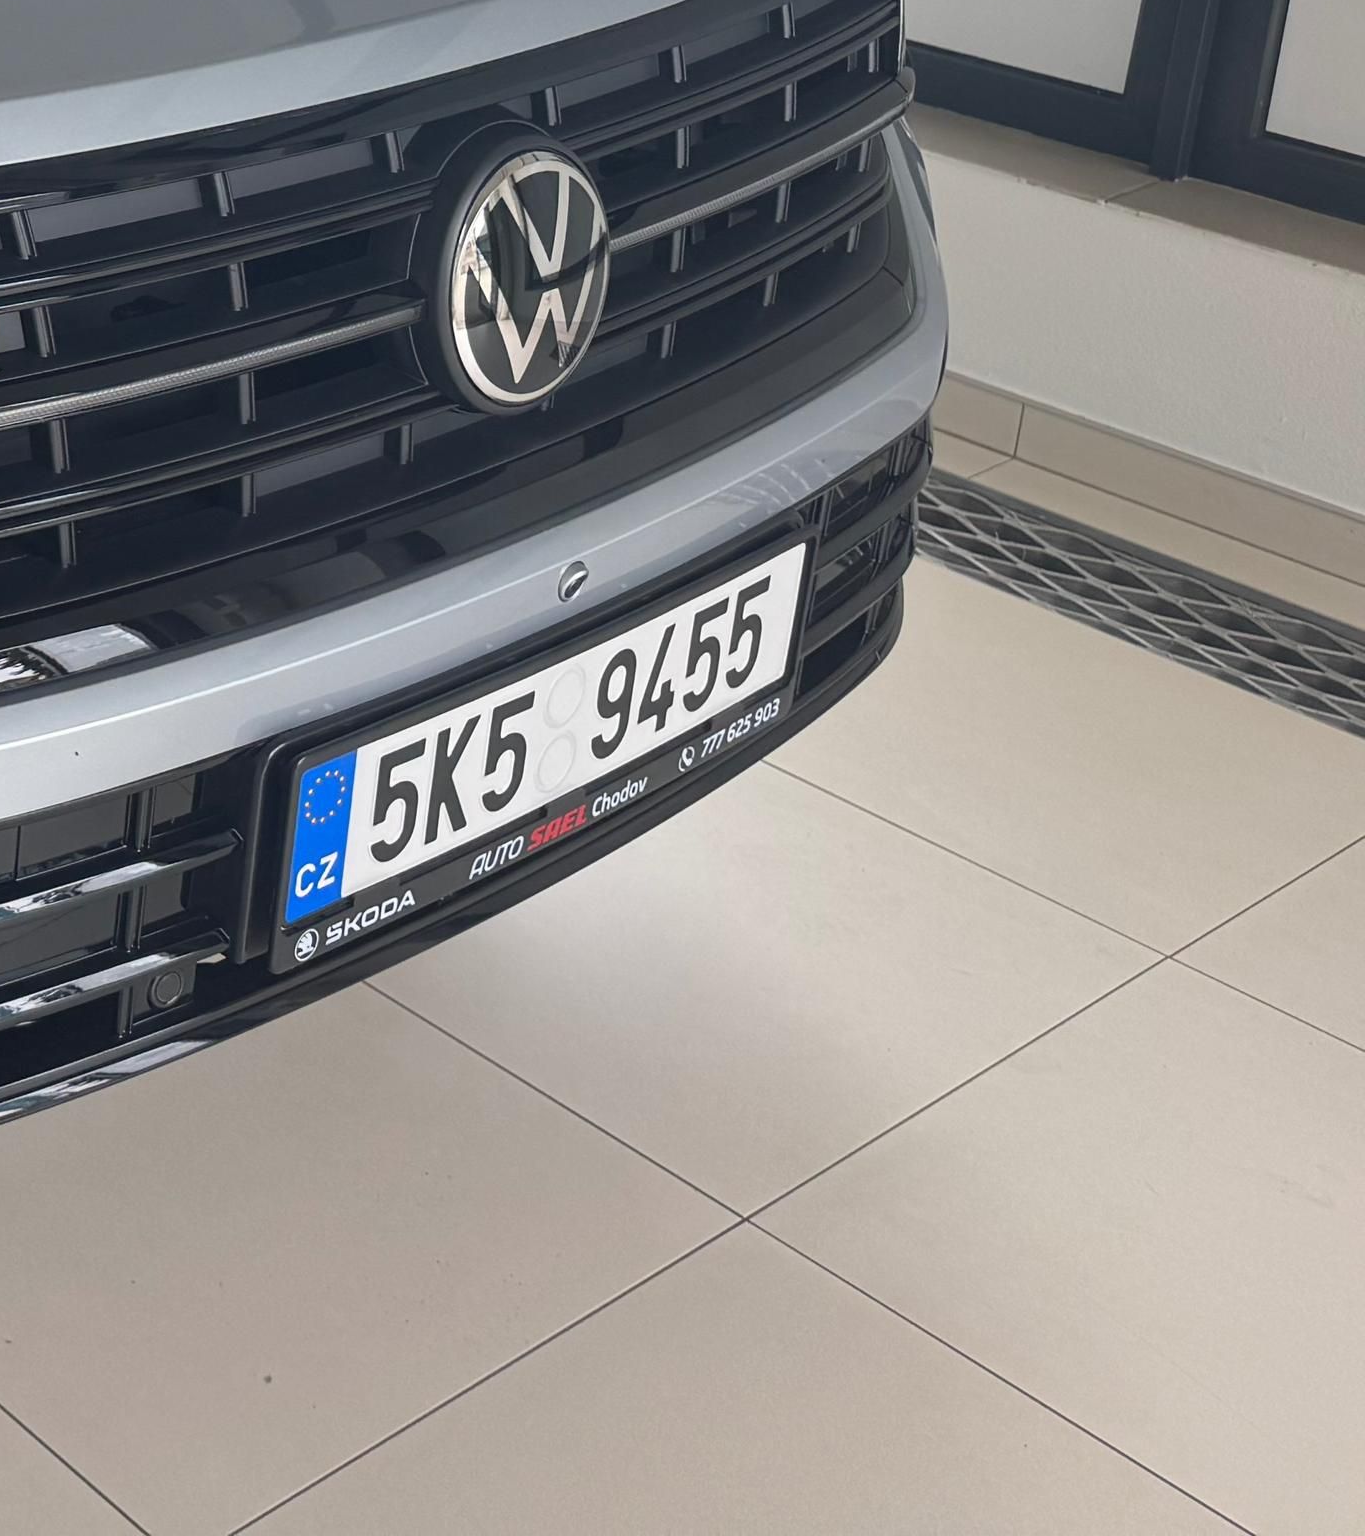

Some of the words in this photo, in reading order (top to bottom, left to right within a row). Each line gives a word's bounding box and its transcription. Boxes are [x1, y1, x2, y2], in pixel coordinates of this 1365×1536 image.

[370, 690, 536, 863] 5K5
[591, 575, 772, 760] 9455
[701, 728, 726, 758] 777
[727, 713, 752, 743] 625
[754, 697, 780, 727] 903
[469, 835, 525, 880] AUTO
[592, 776, 649, 817] Chodov
[295, 851, 338, 898] CZ
[325, 890, 416, 946] SKODA
